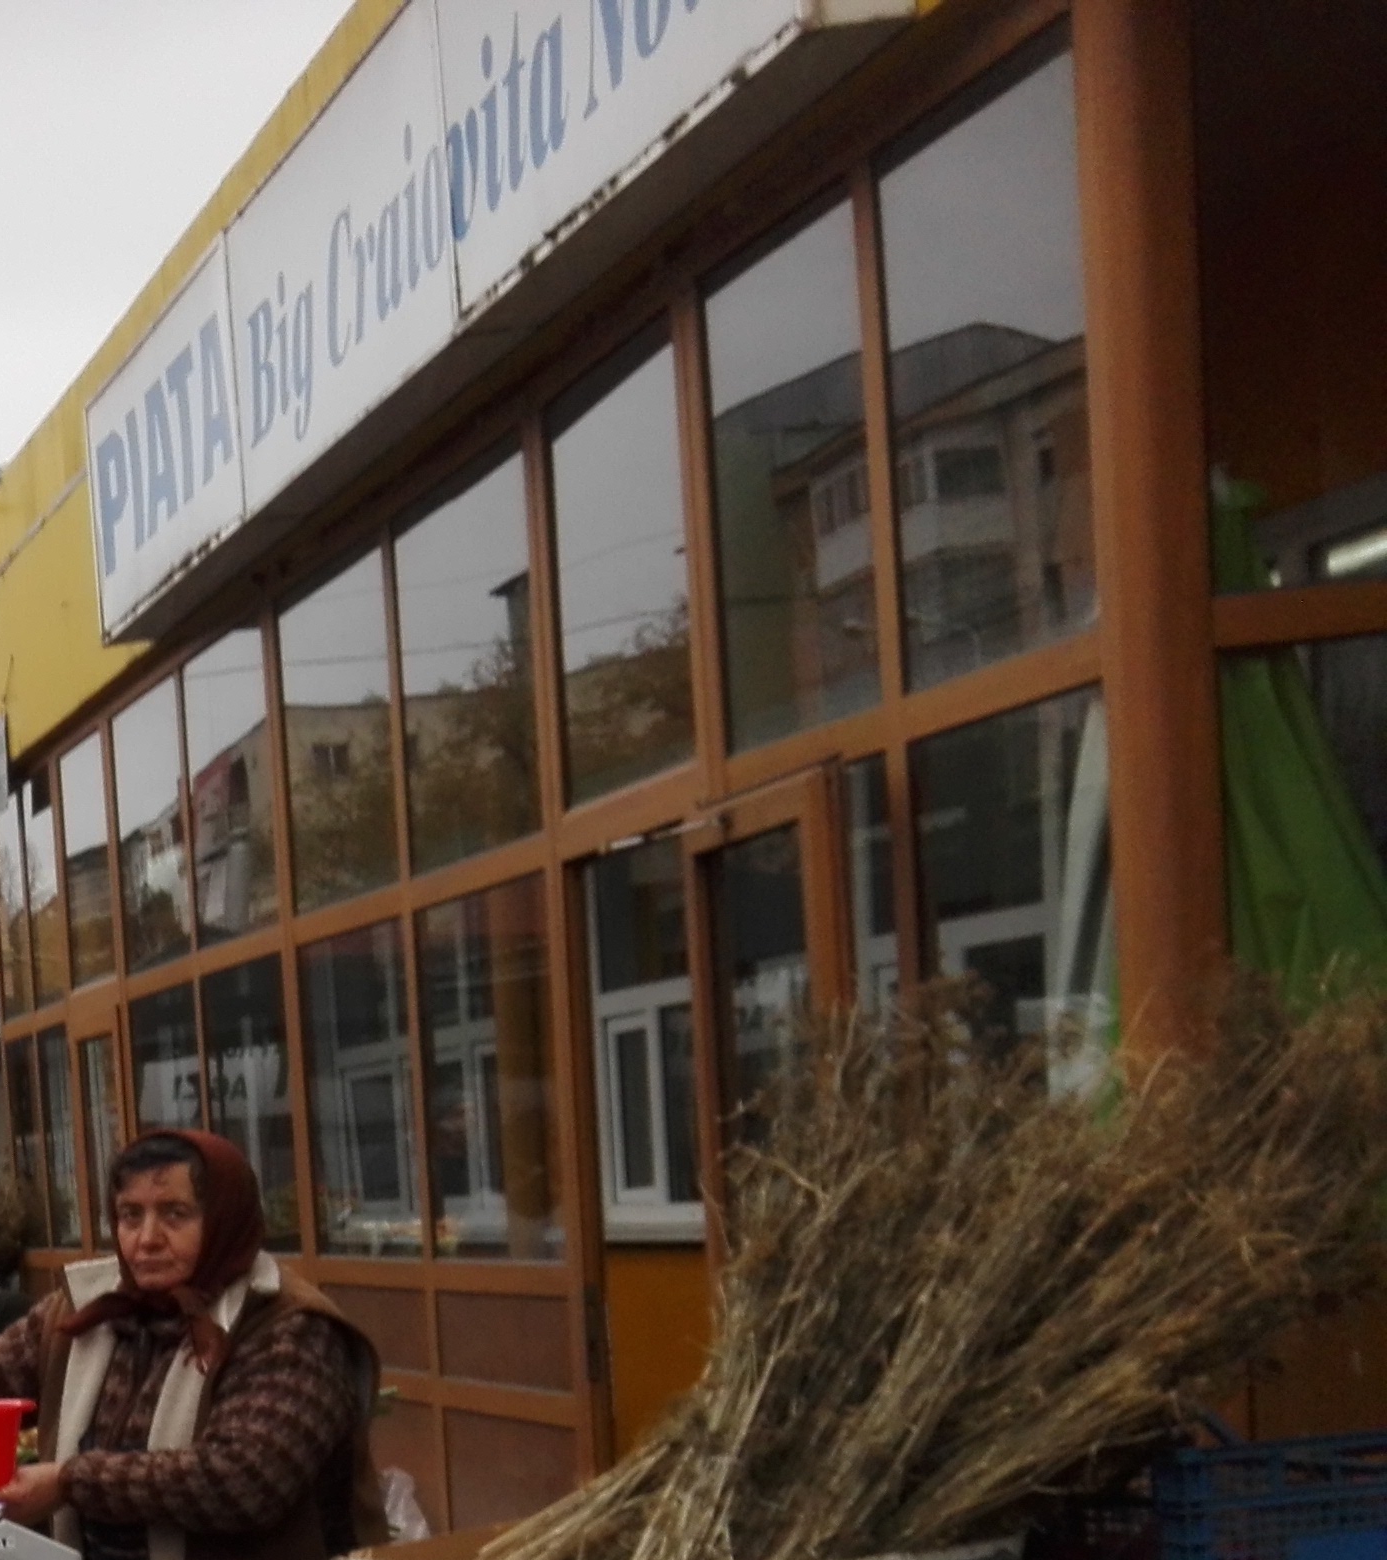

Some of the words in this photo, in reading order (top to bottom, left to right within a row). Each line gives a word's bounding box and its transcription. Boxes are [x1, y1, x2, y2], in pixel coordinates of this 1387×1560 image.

[96, 310, 235, 578] PIATA
[246, 270, 314, 448] Big
[327, 10, 570, 368] Craiovita
